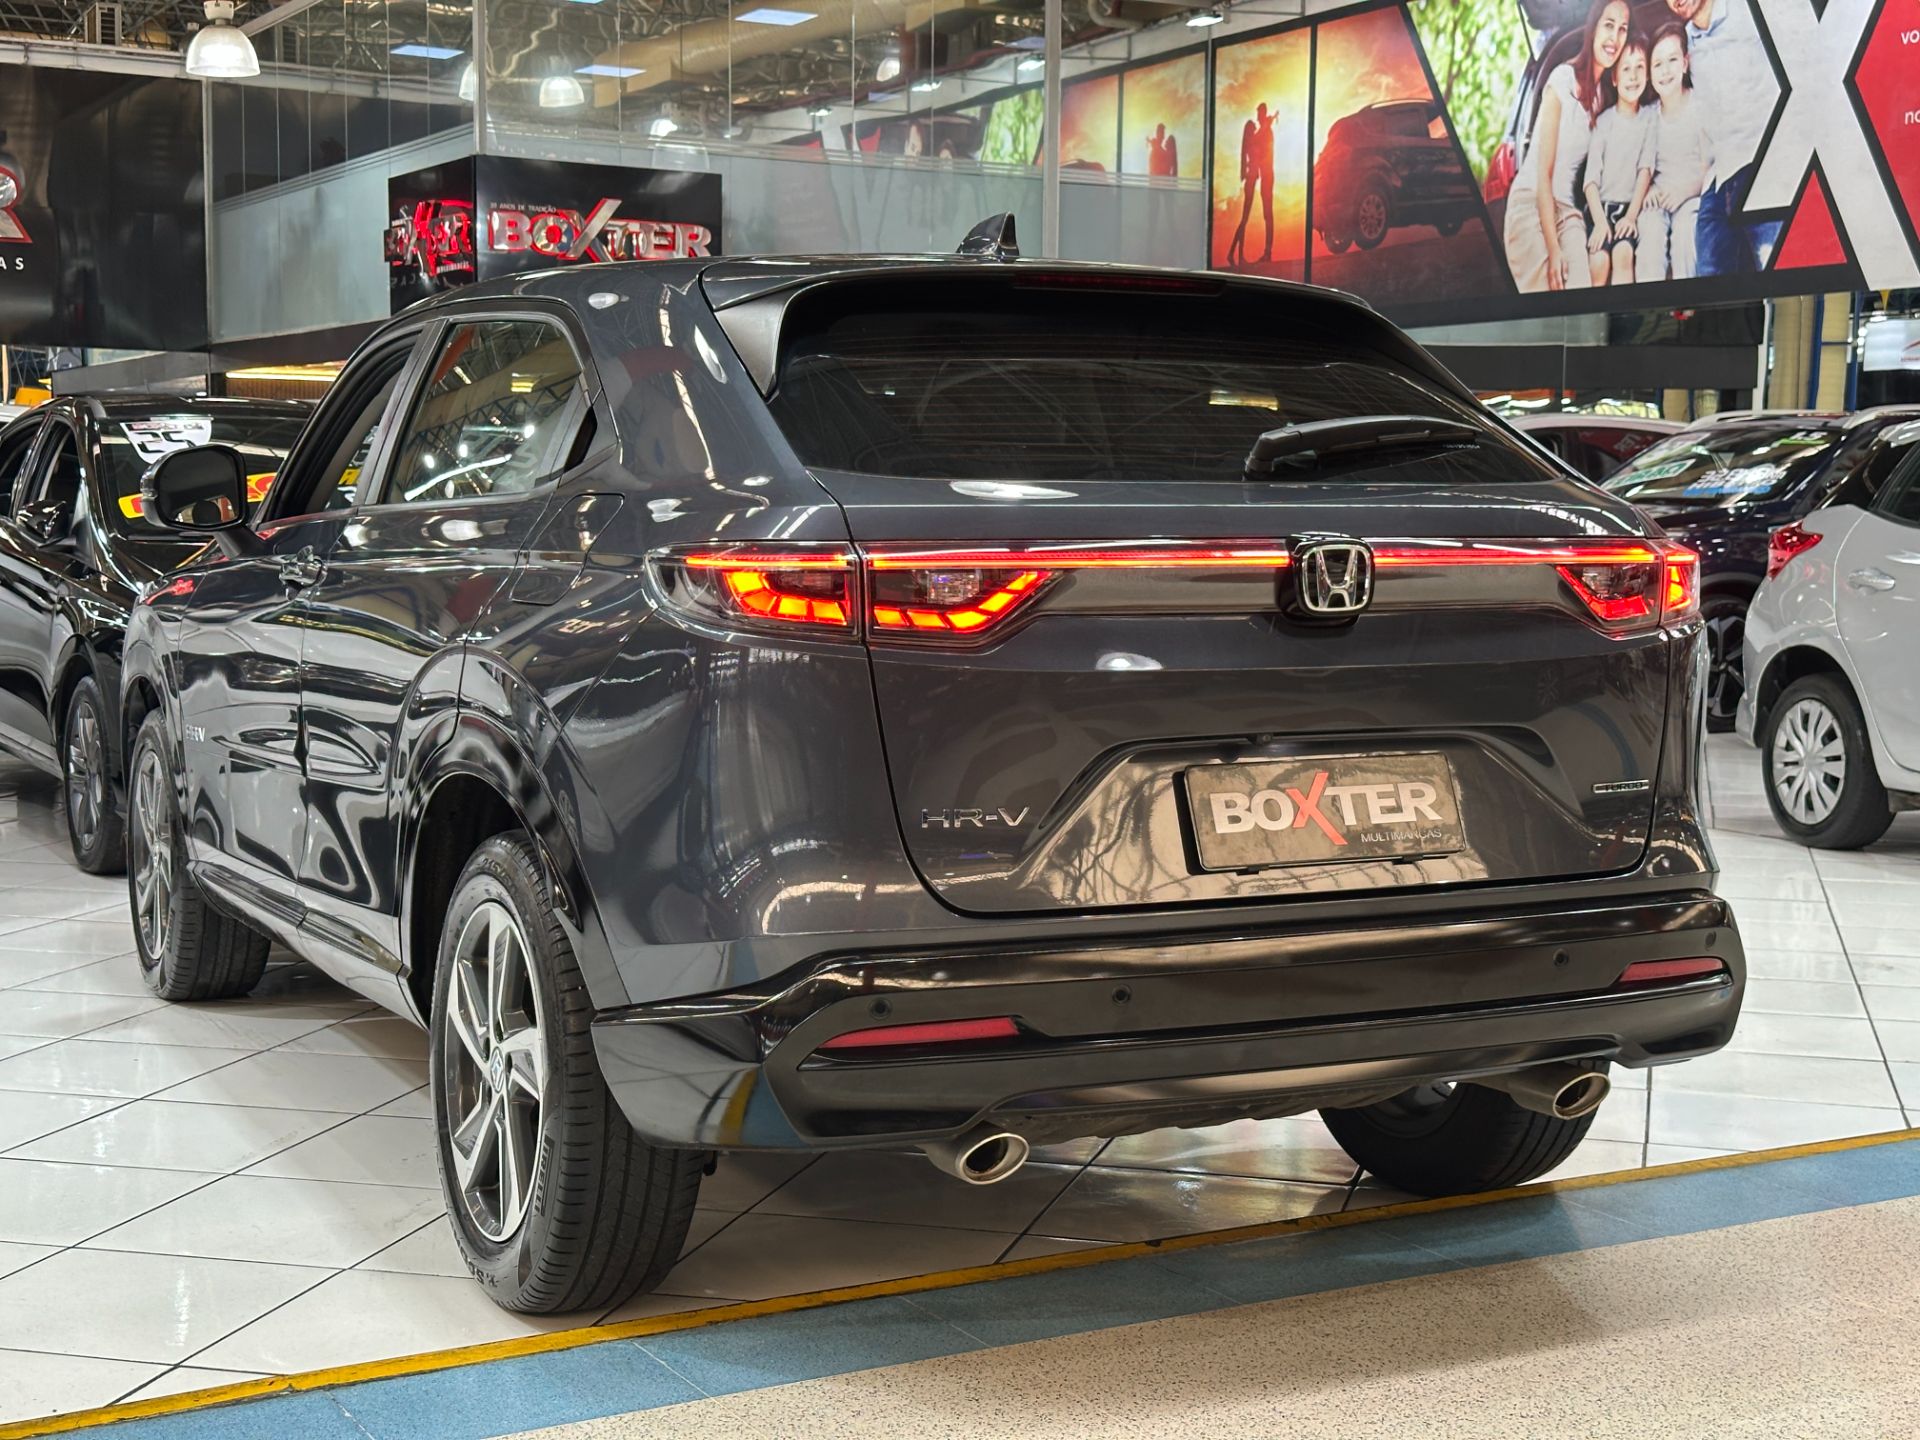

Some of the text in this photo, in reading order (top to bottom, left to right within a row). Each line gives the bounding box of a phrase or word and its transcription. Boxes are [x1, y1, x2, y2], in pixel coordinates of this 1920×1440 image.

[487, 198, 712, 262] BOXTER
[921, 806, 1030, 829] HR-V
[1209, 771, 1444, 847] BOXTER
[1360, 827, 1443, 843] MULTIMARCAS
